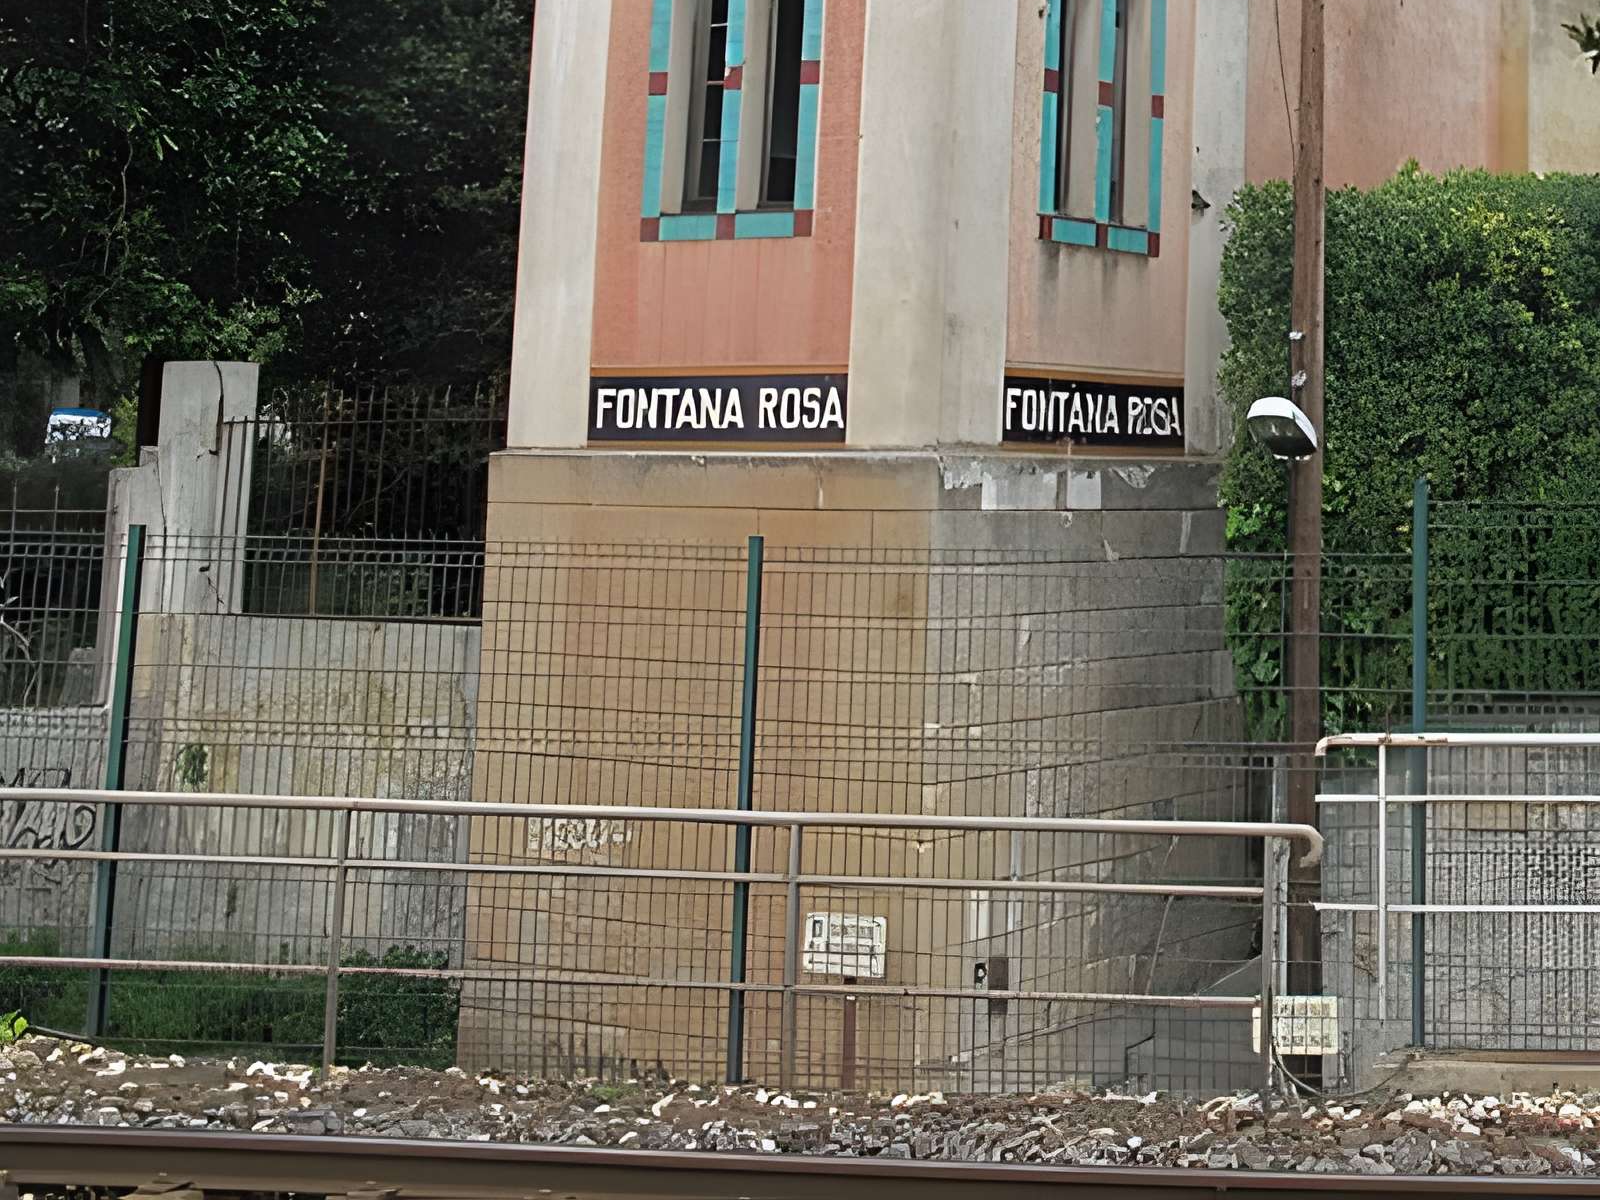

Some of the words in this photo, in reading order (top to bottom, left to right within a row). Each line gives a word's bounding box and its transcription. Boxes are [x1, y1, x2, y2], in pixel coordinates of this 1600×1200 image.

[595, 387, 745, 429] FONTANA
[757, 385, 845, 430] ROSA
[1005, 387, 1120, 434] FONTANA
